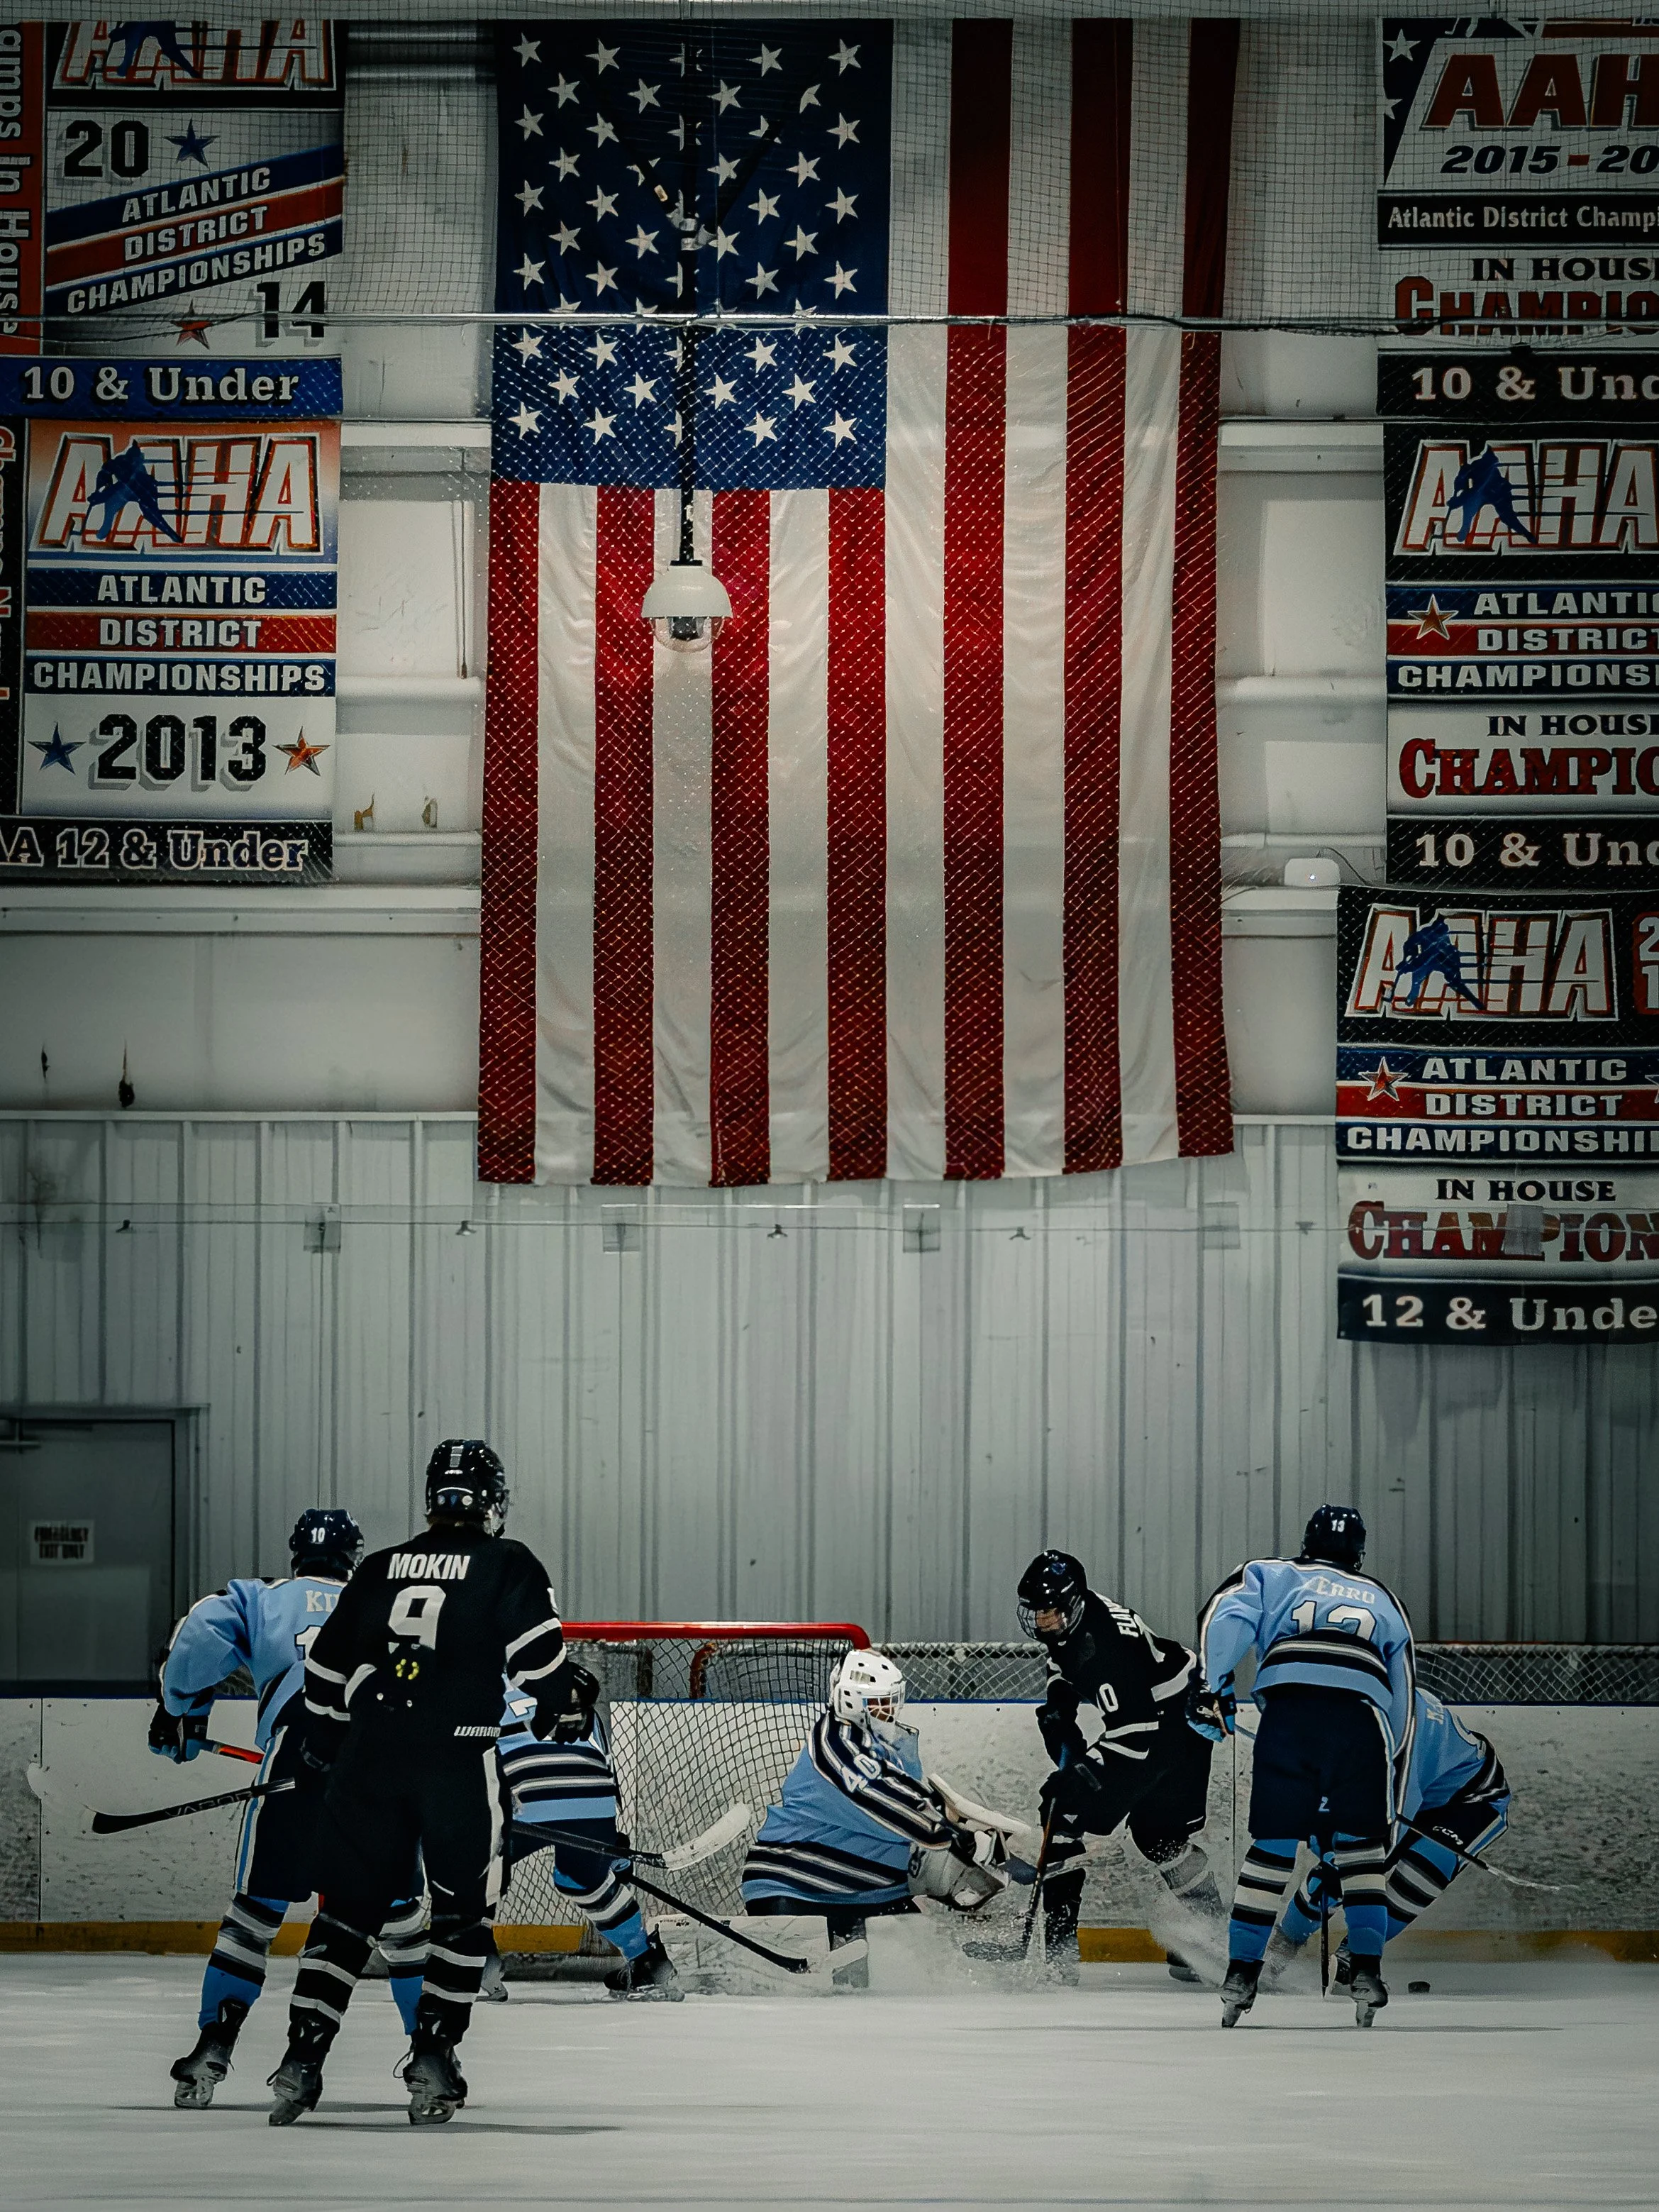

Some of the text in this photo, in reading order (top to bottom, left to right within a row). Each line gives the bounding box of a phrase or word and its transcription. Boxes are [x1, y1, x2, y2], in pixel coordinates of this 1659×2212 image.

[0, 21, 22, 138] amps
[64, 120, 149, 178] 20
[122, 167, 271, 223] ATLANTIC
[124, 206, 268, 261] DISTRICT
[1388, 206, 1475, 228] Atlantic
[1484, 206, 1568, 228] District
[67, 233, 326, 314] CHAMPIONSHIPS
[1471, 258, 1659, 282] IN HOUS
[257, 281, 326, 339] 14
[24, 366, 299, 402] 10 & Under
[1411, 367, 1471, 400] 10
[1495, 367, 1536, 400] &
[27, 433, 324, 556] AAHA
[1393, 439, 1659, 556] AAHA
[97, 575, 267, 603] ATLANTIC
[99, 619, 262, 648] DISTRICT
[33, 662, 326, 692] CHAMPIONSHIPS
[1398, 664, 1659, 687] CHAMPIONS
[1487, 714, 1526, 737] IN
[96, 714, 267, 783] 2013
[0, 827, 309, 872] A 12 & Under
[1416, 833, 1475, 868] 10
[1499, 833, 1541, 868] &
[1345, 904, 1619, 1022] AAHA
[1421, 1058, 1627, 1082] ATLANTIC
[1426, 1093, 1623, 1117] DISTRICT
[1436, 1178, 1616, 1202] IN HOUSE
[1363, 1294, 1658, 1332] 12 & Unde
[311, 1527, 326, 1544] 10
[387, 1553, 471, 1580] MOKIN
[387, 1585, 447, 1651] 9
